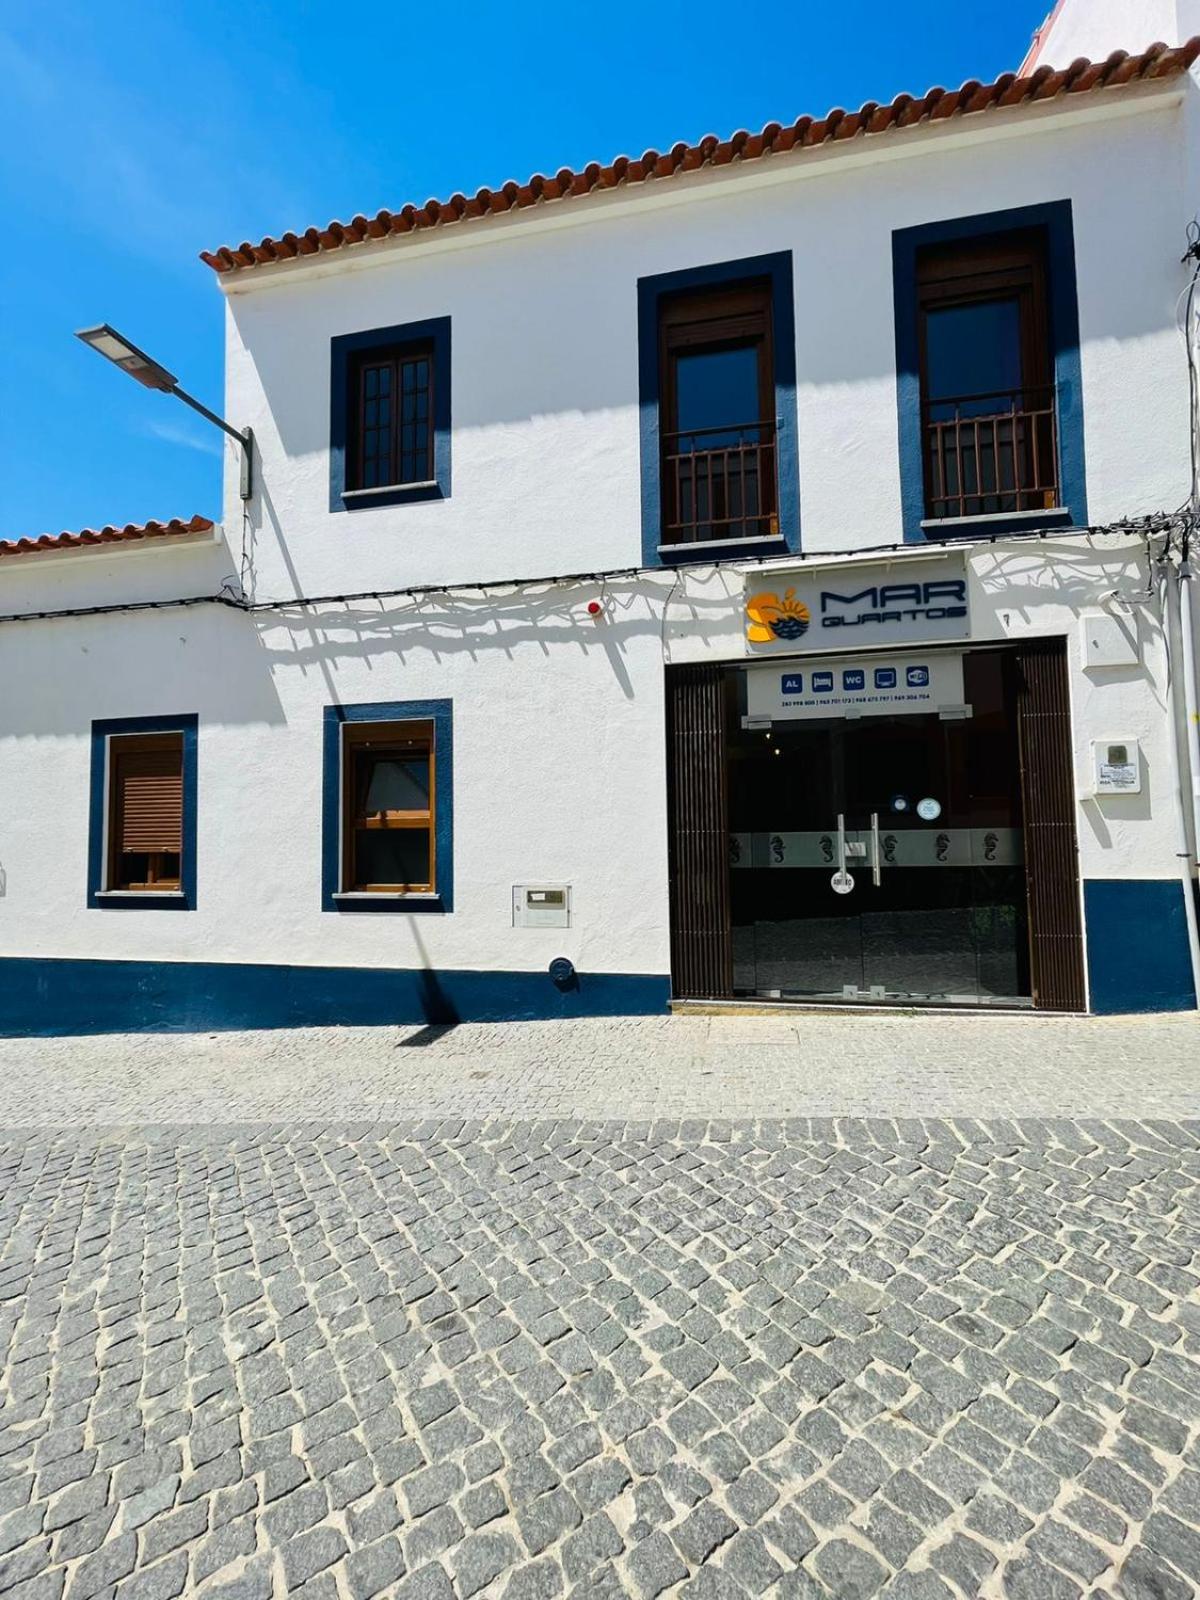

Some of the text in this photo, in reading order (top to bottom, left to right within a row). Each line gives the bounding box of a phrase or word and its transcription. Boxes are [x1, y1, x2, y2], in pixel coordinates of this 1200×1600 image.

[821, 580, 966, 612] MAR
[821, 606, 967, 628] QUARTOS
[785, 680, 799, 688] AL
[845, 675, 862, 684] WC
